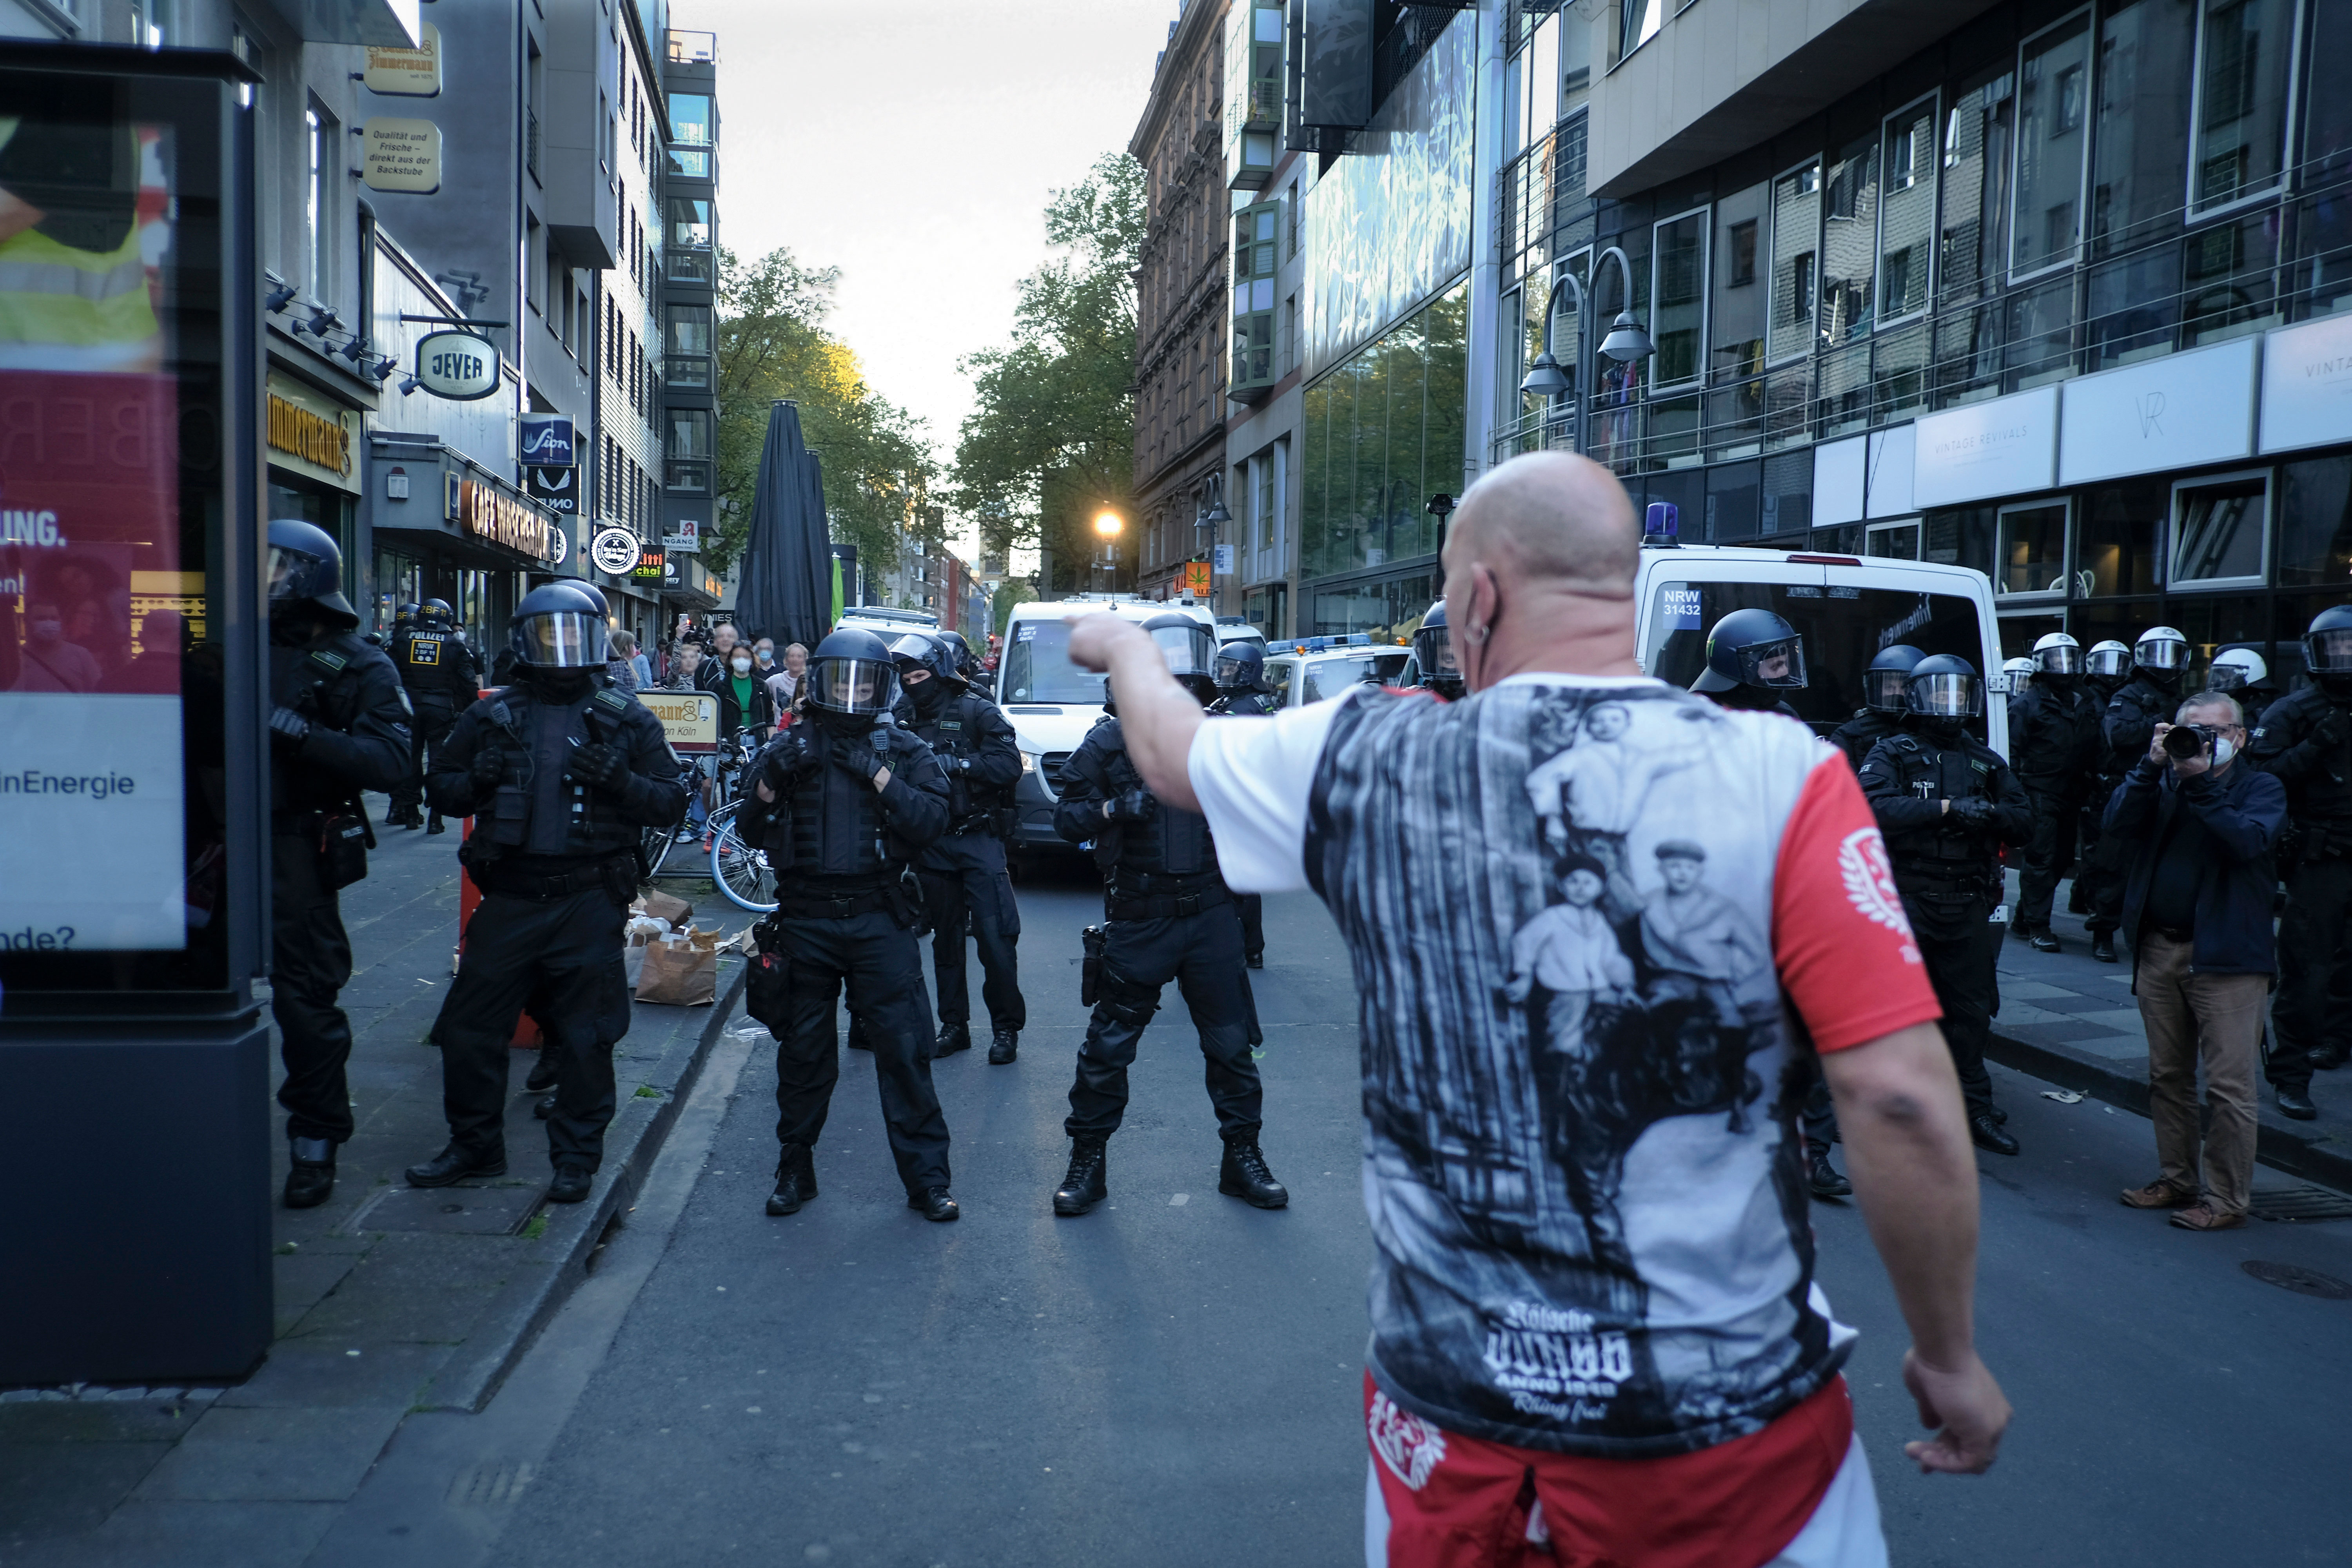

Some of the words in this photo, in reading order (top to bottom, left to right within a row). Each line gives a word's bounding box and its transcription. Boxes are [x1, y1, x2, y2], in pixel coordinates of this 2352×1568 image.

[374, 131, 408, 140] Qualität
[380, 142, 412, 152] Frische
[369, 154, 395, 162] direkt
[416, 156, 431, 165] der
[377, 165, 423, 176] Backstube
[432, 353, 482, 380] JEVER
[522, 428, 570, 454] Sion
[1935, 436, 1974, 454] VINTAGE
[1980, 425, 2027, 445] REVIVALS
[639, 553, 662, 565] itti
[1665, 591, 1699, 602] NRW
[1664, 604, 1700, 615] 31432
[408, 632, 445, 641] POLIZEI
[677, 726, 696, 736] Köln
[1494, 1373, 1561, 1394] ANNO
